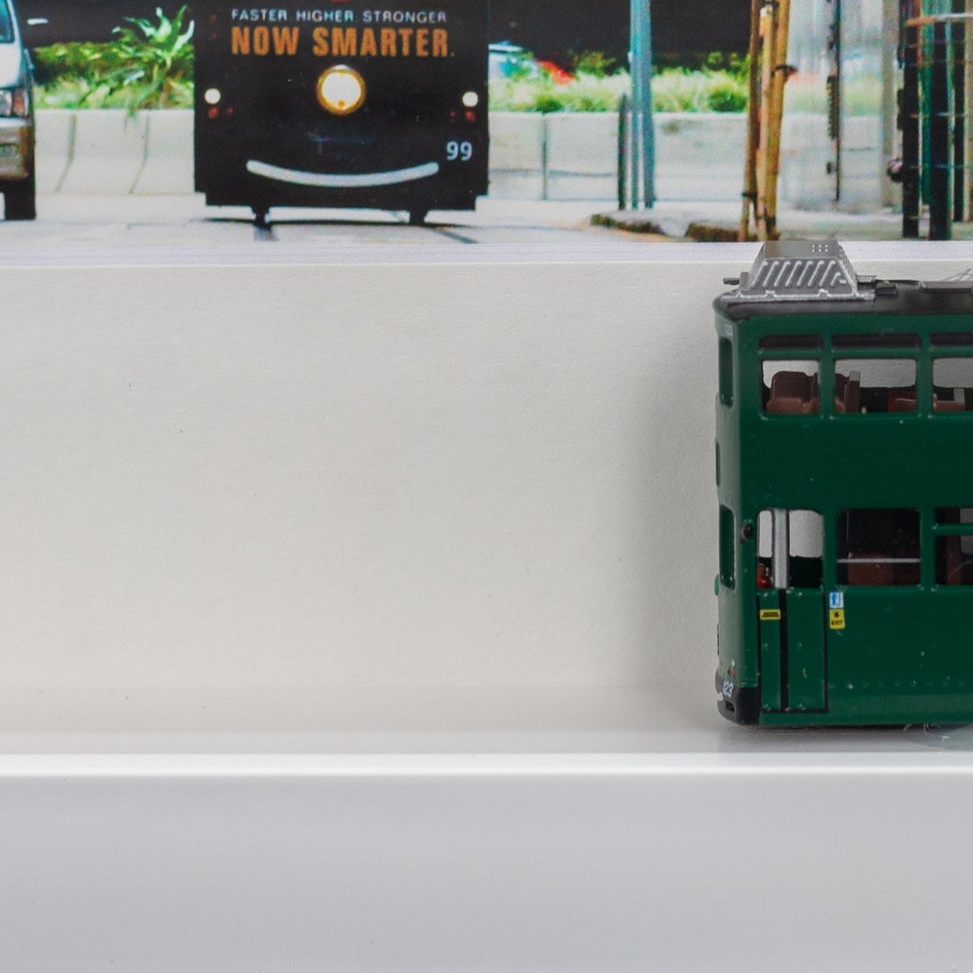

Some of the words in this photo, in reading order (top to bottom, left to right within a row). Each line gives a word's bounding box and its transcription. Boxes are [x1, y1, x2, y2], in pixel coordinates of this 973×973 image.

[231, 8, 288, 22] FASTER
[296, 9, 354, 23] HIGHER
[362, 10, 447, 24] STRONGER
[231, 26, 299, 56] NOW
[312, 27, 449, 58] SMARTER
[445, 140, 474, 162] 99
